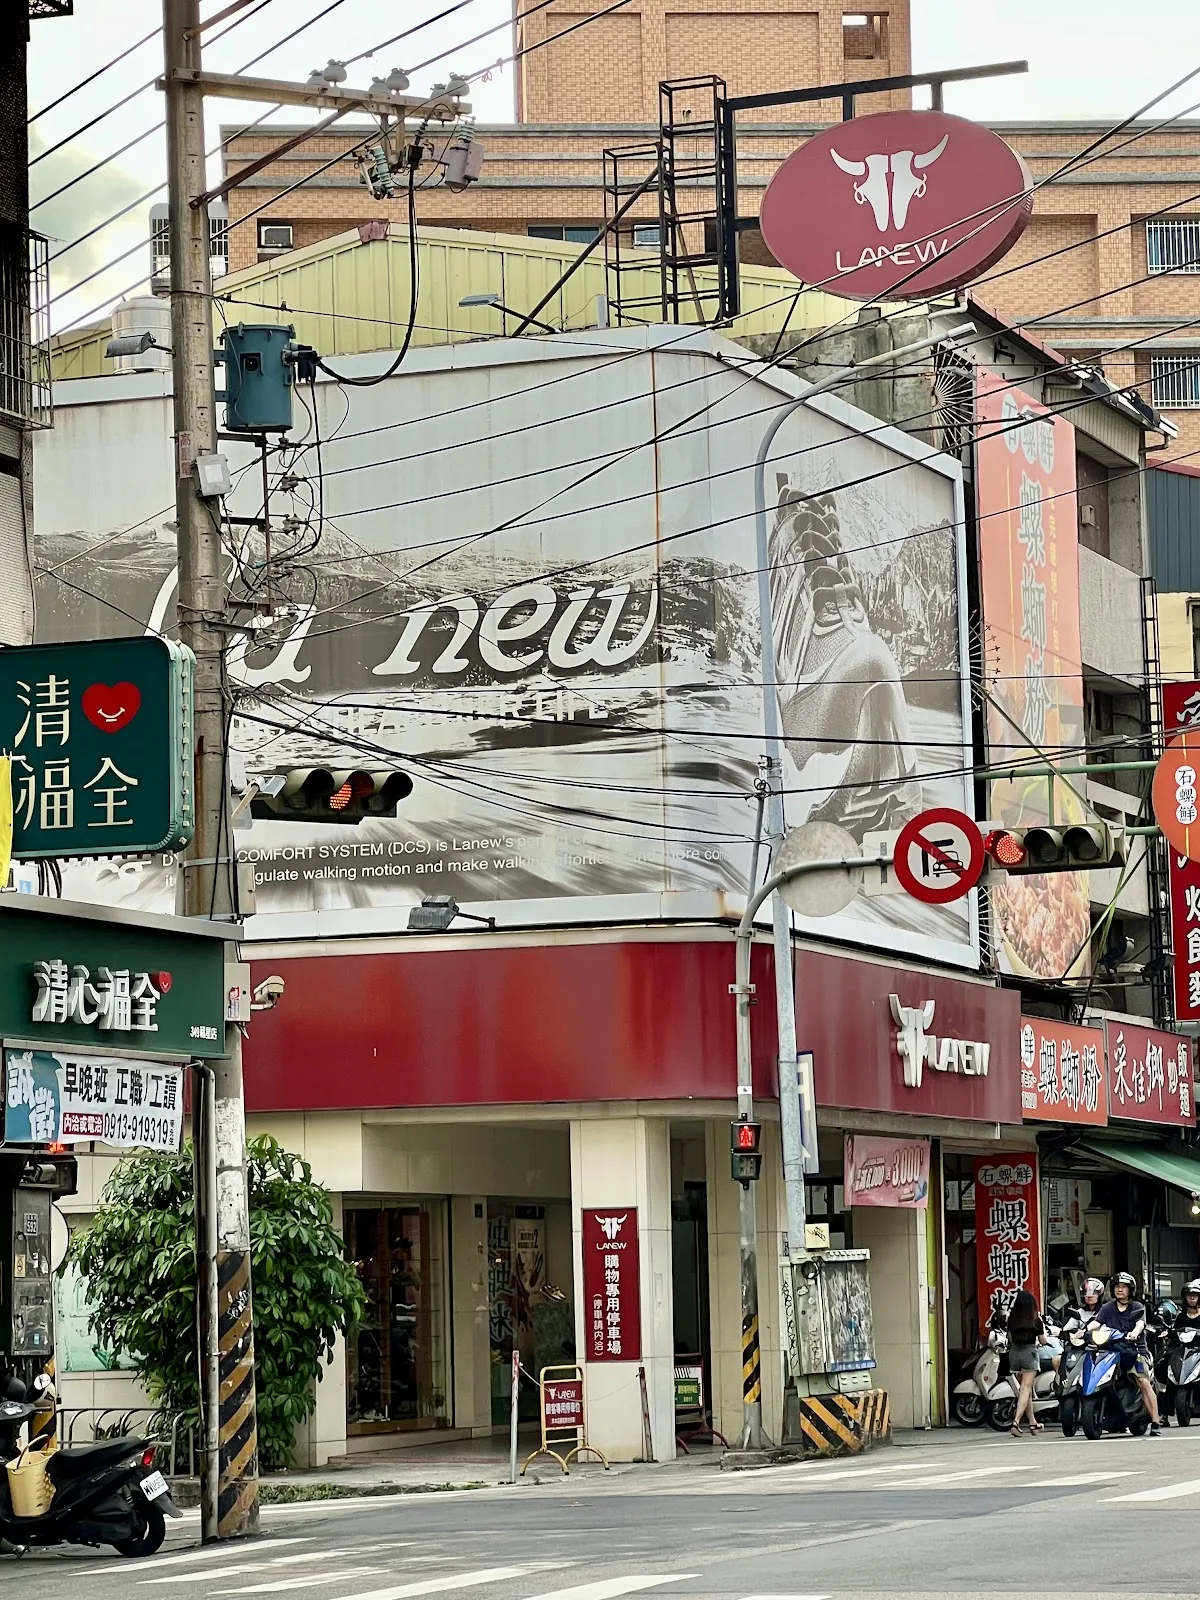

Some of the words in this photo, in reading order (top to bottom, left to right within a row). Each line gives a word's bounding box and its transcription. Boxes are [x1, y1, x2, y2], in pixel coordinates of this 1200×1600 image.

[836, 239, 951, 271] LANEW
[372, 582, 662, 675] new
[15, 674, 70, 748] 清
[15, 757, 139, 831] 福全
[1178, 767, 1197, 823] 石螺鮮
[237, 846, 315, 863] COMFORT
[318, 843, 384, 859] SYSTEM
[388, 840, 431, 858] (DCS)
[436, 840, 448, 851] is
[453, 836, 514, 851] Lanew's
[254, 868, 299, 885] gulate
[303, 866, 357, 881] walking
[361, 862, 411, 878] motion
[415, 859, 443, 874] and
[447, 857, 489, 872] make
[33, 959, 161, 1032] 清心福全
[63, 1062, 109, 1103] 早晚班
[104, 1113, 169, 1145] 0913-919319
[980, 1166, 1032, 1184] 石螺鮮
[596, 1242, 627, 1250] LANEW
[604, 1254, 622, 1355] 購物專用停車場
